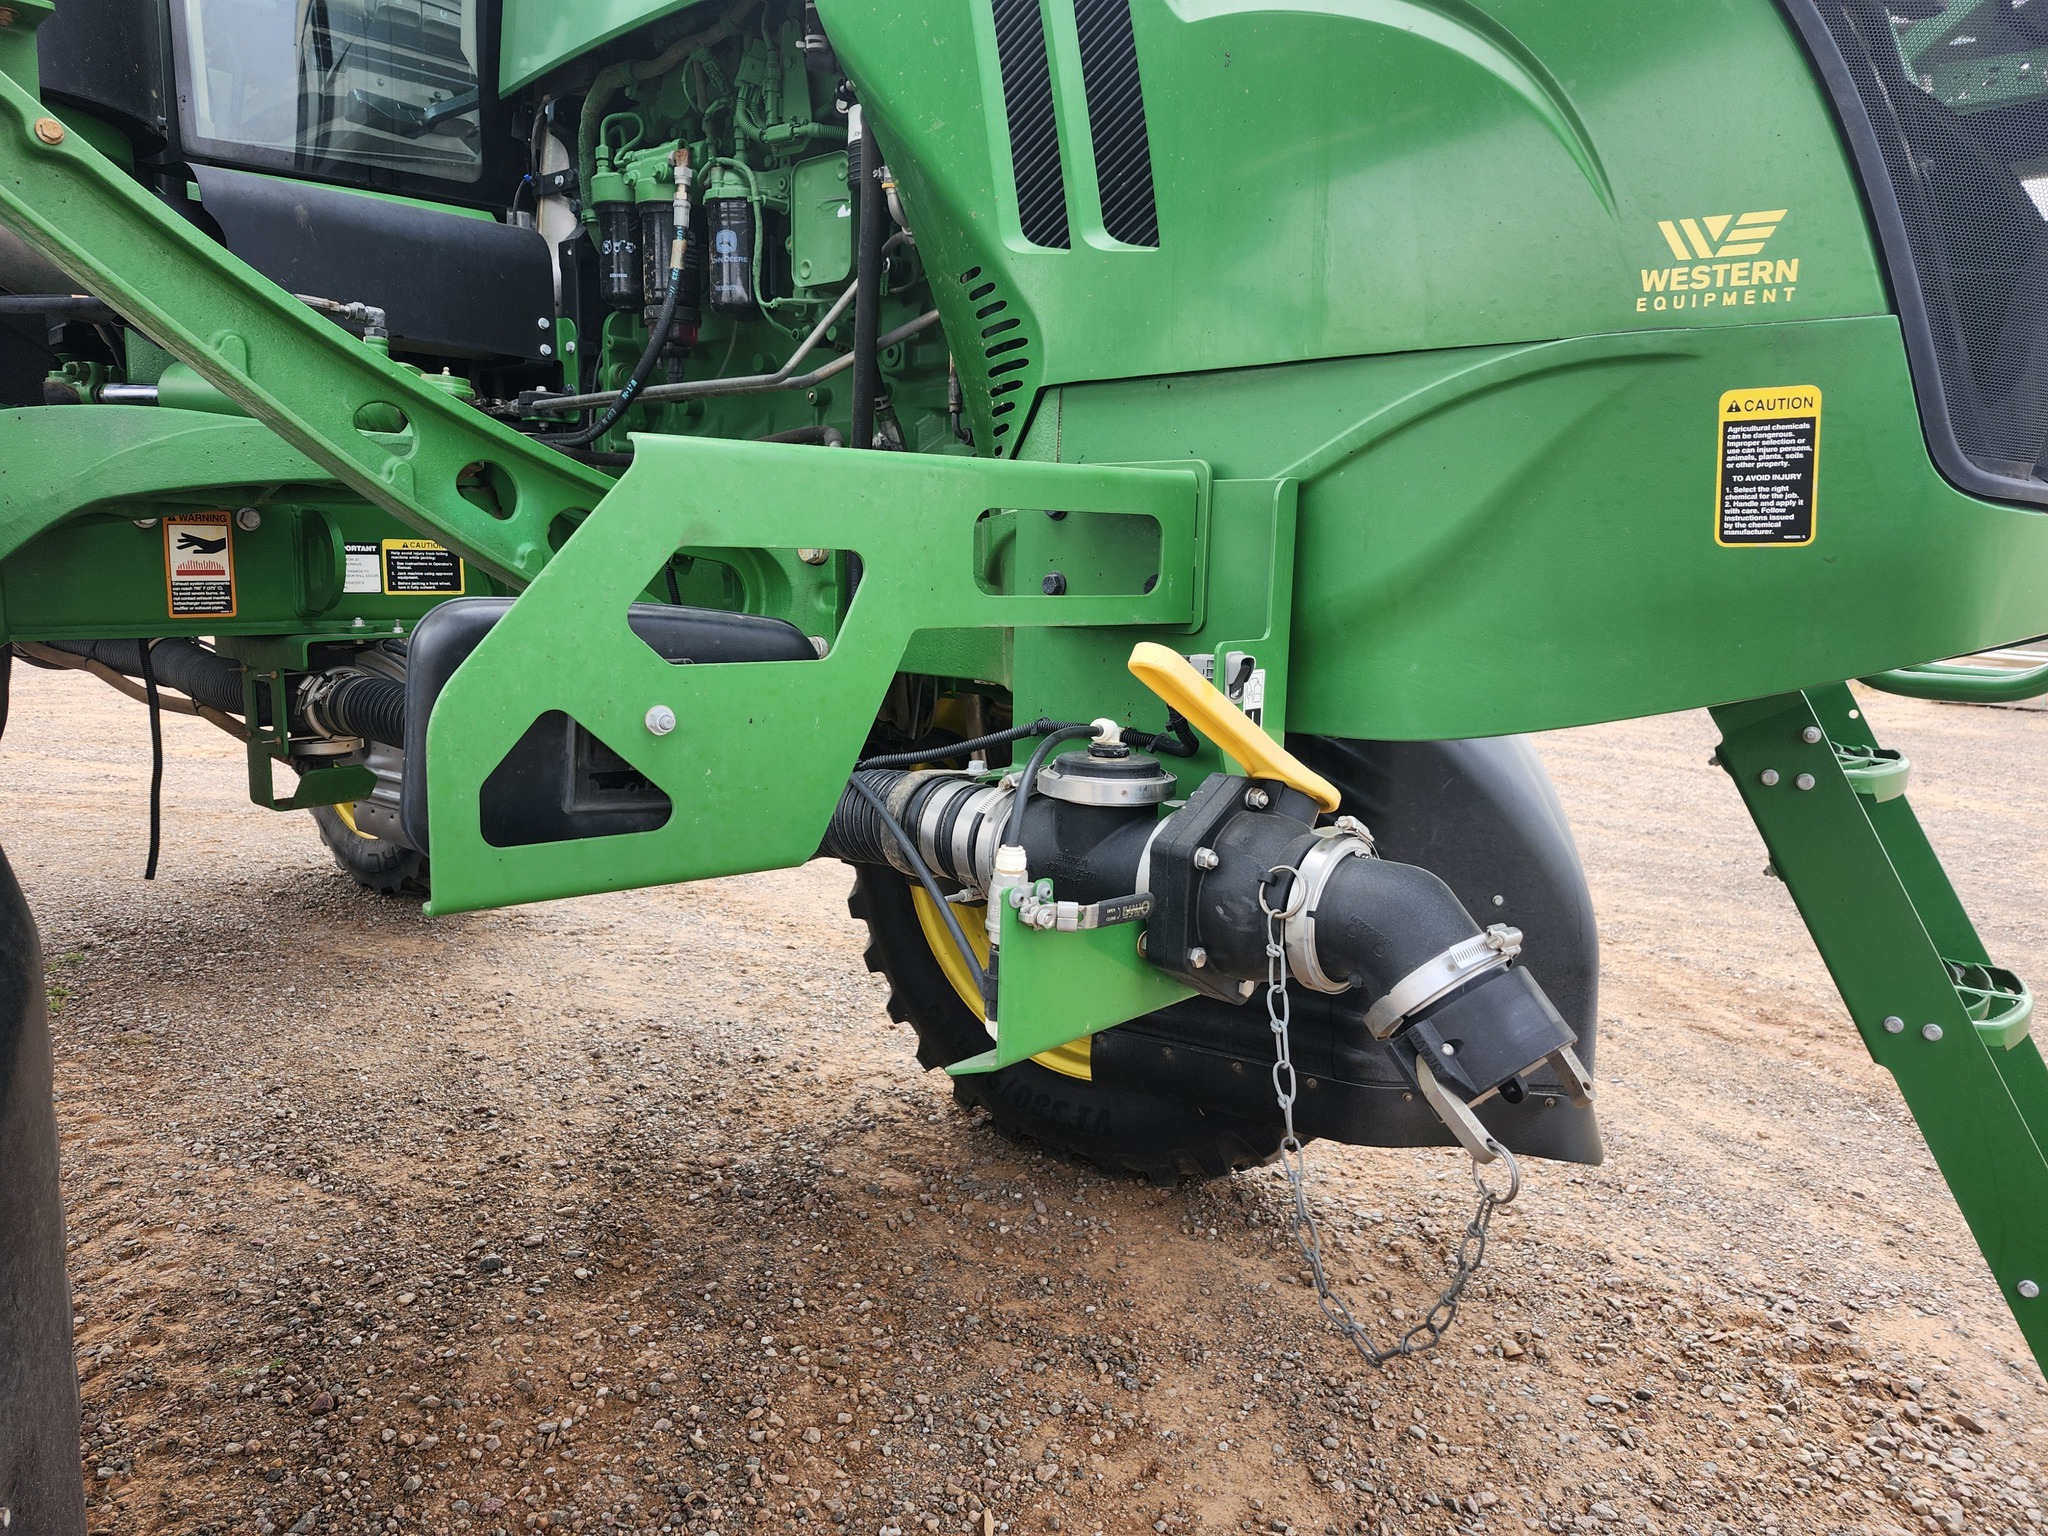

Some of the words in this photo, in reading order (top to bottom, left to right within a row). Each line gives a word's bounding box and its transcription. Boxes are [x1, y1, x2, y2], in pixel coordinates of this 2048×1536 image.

[1640, 258, 1799, 292] WESTERN
[1636, 287, 1796, 312] EQUIPMENT
[1744, 396, 1814, 412] CAUTION
[1728, 425, 1770, 433] Agricultural
[1757, 446, 1778, 455] injure
[1776, 499, 1796, 507] apply
[179, 514, 227, 522] WARNING
[1410, 1030, 1443, 1074] BANJO
[1566, 1050, 1581, 1071] NJO
